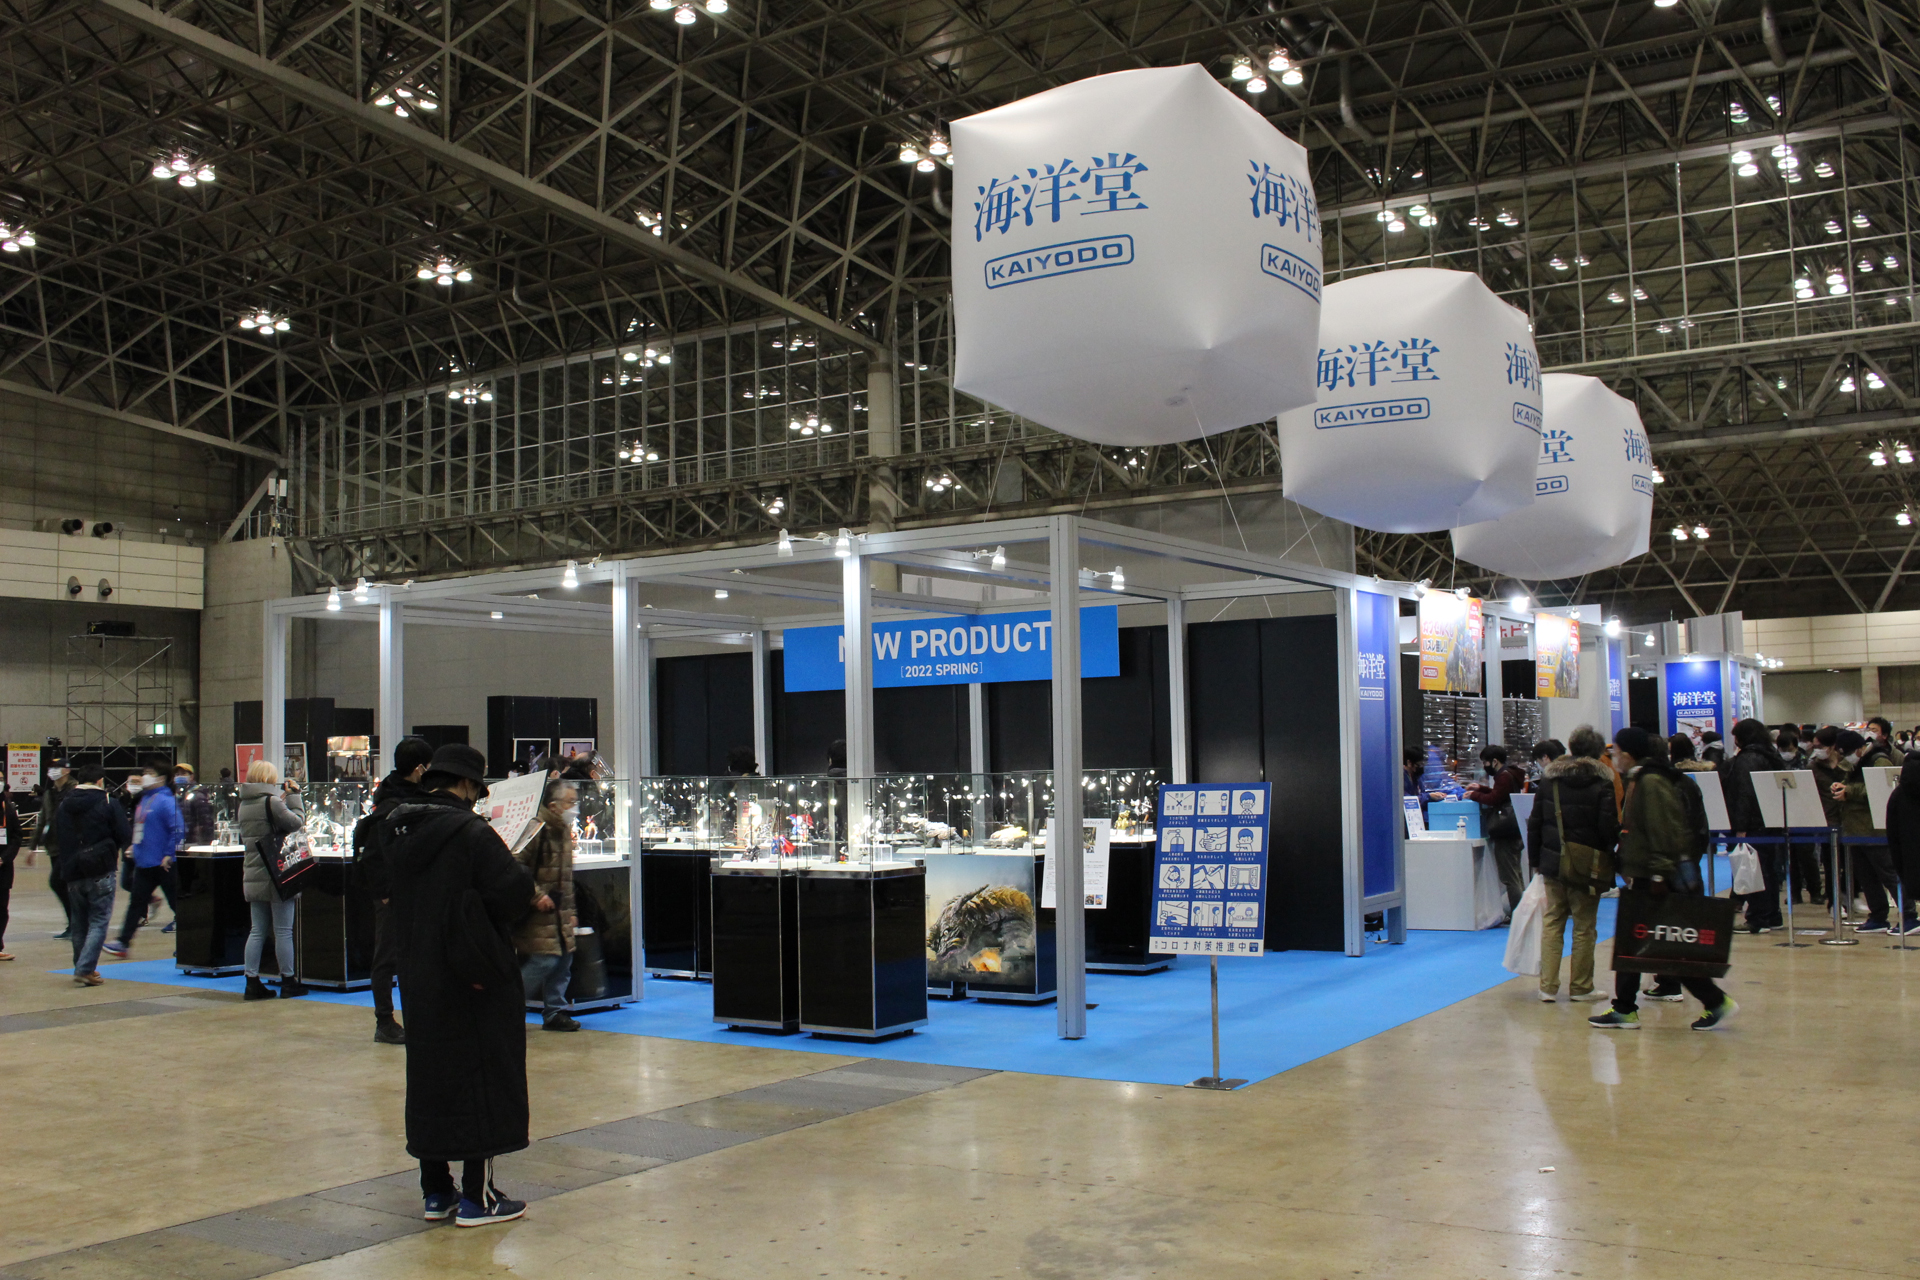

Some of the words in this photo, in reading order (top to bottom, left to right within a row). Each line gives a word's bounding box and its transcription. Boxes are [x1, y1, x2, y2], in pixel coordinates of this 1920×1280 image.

[974, 152, 1149, 242] 海洋堂
[991, 243, 1123, 280] KAIYODO
[1320, 403, 1422, 424] KAIYODO
[1672, 691, 1717, 706] 海洋堂
[1161, 940, 1247, 953] コロナ対策推進中
